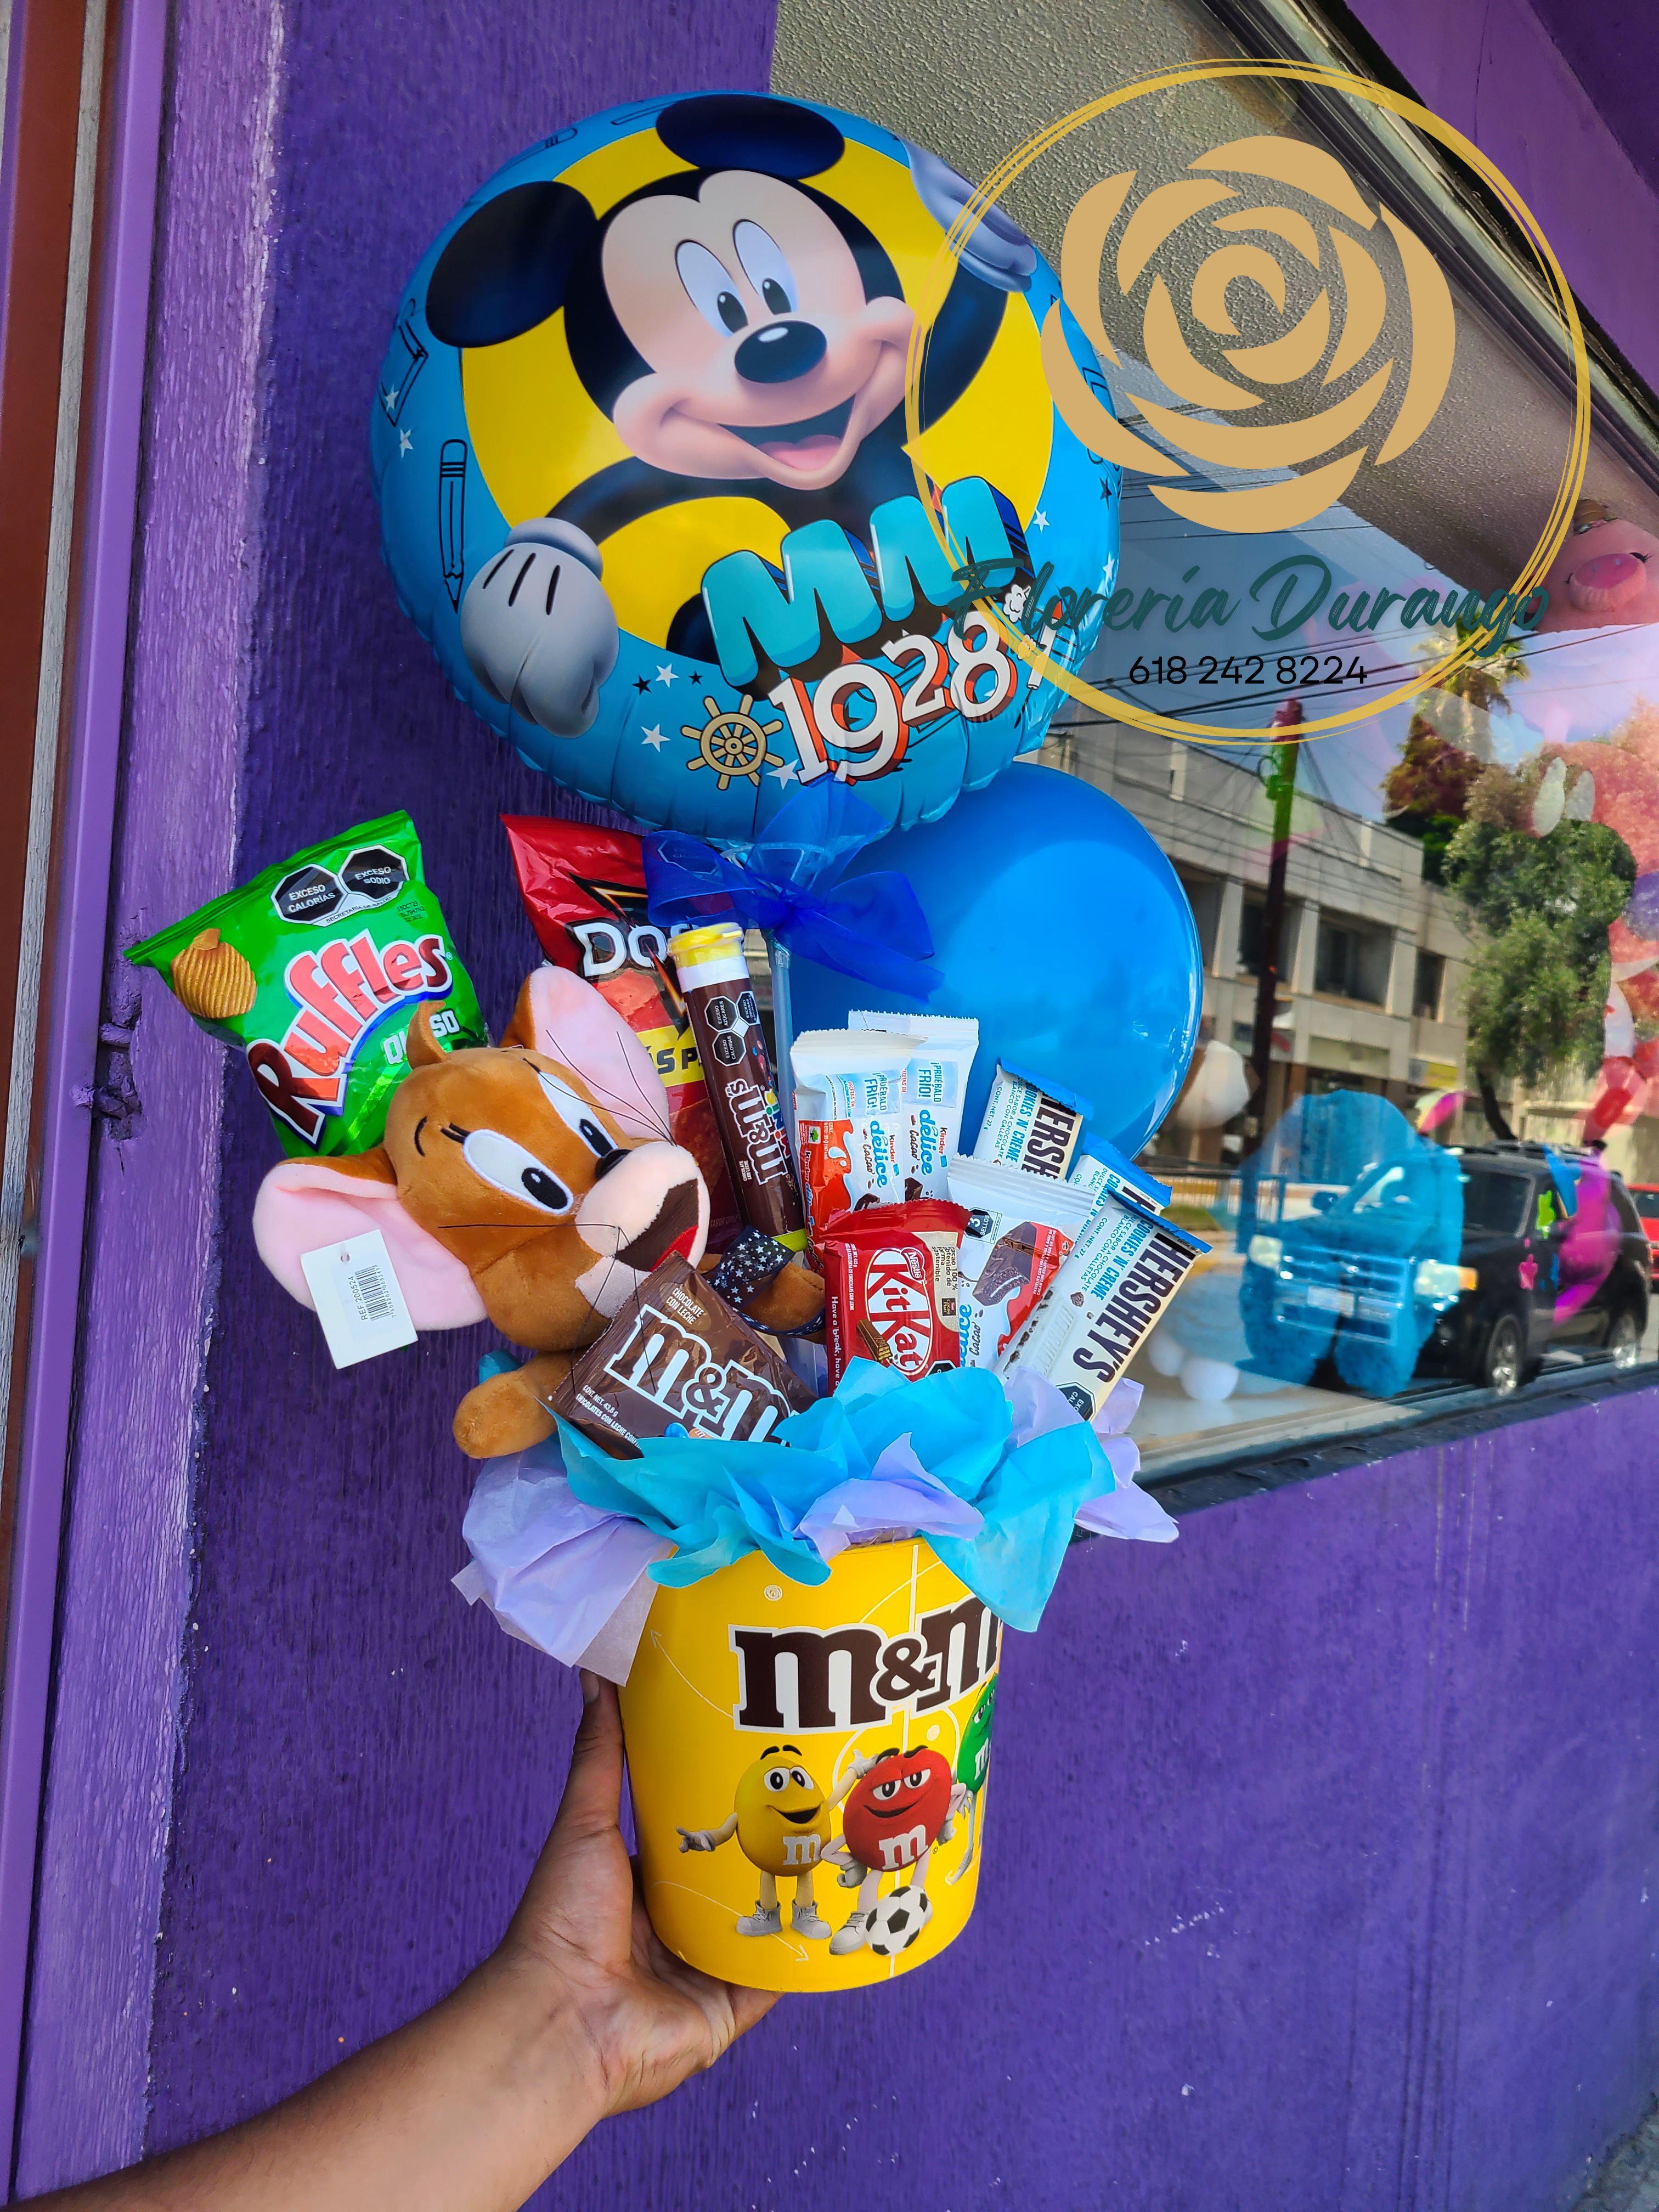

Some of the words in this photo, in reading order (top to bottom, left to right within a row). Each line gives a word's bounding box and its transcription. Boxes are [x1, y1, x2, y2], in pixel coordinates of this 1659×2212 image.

[768, 610, 1015, 785] 1928
[354, 866, 391, 881] EXCESO
[288, 892, 336, 913] CALORÍAS
[289, 884, 326, 901] EXCESO
[247, 929, 452, 1142] Ruffles
[383, 1010, 460, 1065] QSO
[918, 1069, 933, 1098] FRÍO!
[992, 1086, 1002, 1107] CONT.
[1011, 1094, 1021, 1115] SABOR
[909, 1130, 920, 1161] Cacao
[995, 1119, 1007, 1149] GALLETAS
[998, 1120, 1013, 1159] CHOCOLATE
[1006, 1130, 1025, 1163] CREME
[739, 1160, 748, 1181] CHOCOLATE
[862, 1144, 876, 1175] Cacao
[1088, 1170, 1100, 1188] BLANC
[980, 1215, 990, 1236] SELLOS
[1092, 1217, 1108, 1235] CONT.
[1110, 1214, 1130, 1239] BLANCO
[1120, 1219, 1154, 1257] COOKIES
[1079, 1248, 1086, 1257] 27
[1083, 1235, 1096, 1248] NET.
[1101, 1238, 1112, 1253] CON
[1109, 1230, 1126, 1251] SABOR
[932, 1246, 941, 1282] sostenible
[1081, 1252, 1102, 1281] GALLETAS
[1081, 1255, 1109, 1292] CHOCOLATE
[1090, 1266, 1120, 1301] CREME
[665, 1296, 680, 1310] CON
[676, 1305, 697, 1325] LECHE
[672, 1287, 704, 1318] CHOCOLATE
[1073, 1232, 1197, 1383] HERSHEY'S
[969, 1321, 981, 1356] Cacao
[575, 1393, 603, 1417] CHOCOLATES
[601, 1414, 613, 1425] CON
[611, 1421, 627, 1435] LECHE
[593, 1394, 605, 1406] NET.
